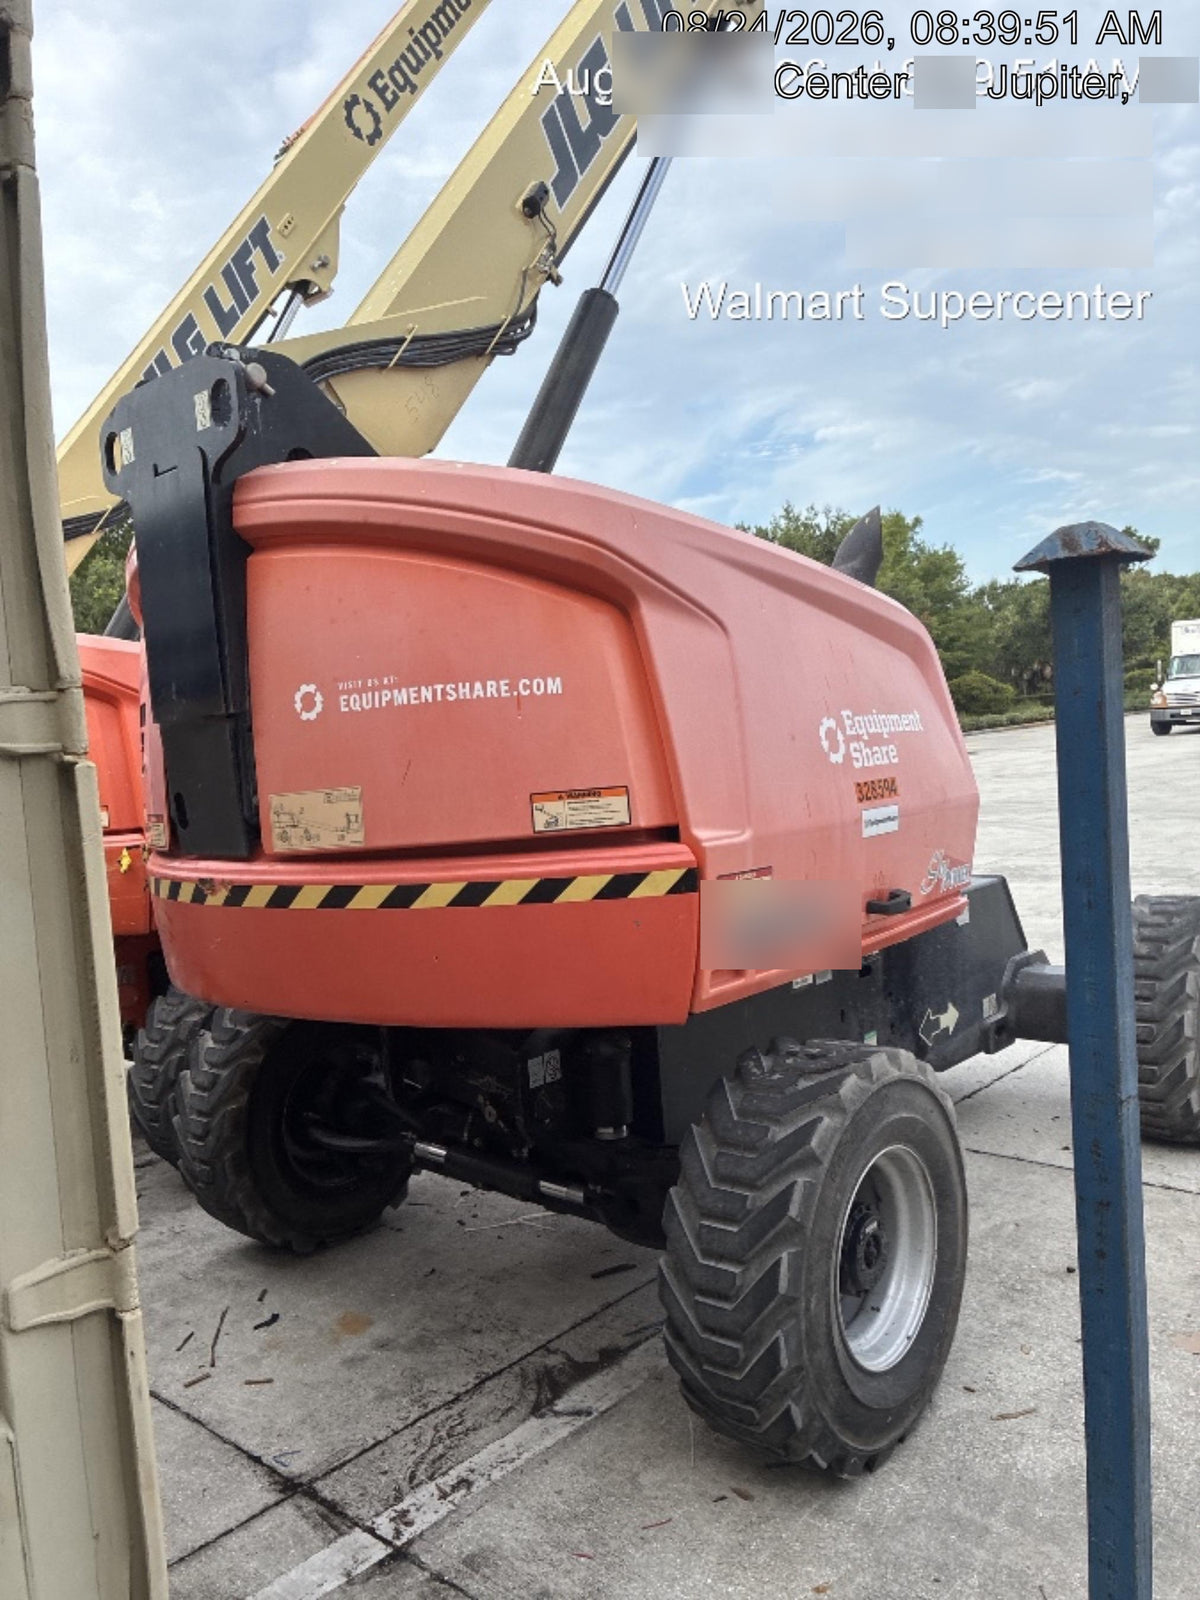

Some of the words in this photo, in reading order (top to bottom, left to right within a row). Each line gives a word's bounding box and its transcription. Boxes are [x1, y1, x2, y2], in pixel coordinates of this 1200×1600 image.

[201, 213, 281, 340] LIFT
[339, 676, 563, 713] EQUIPMENTSHARE.COM
[841, 708, 924, 740] Equipment
[849, 741, 899, 769] Share
